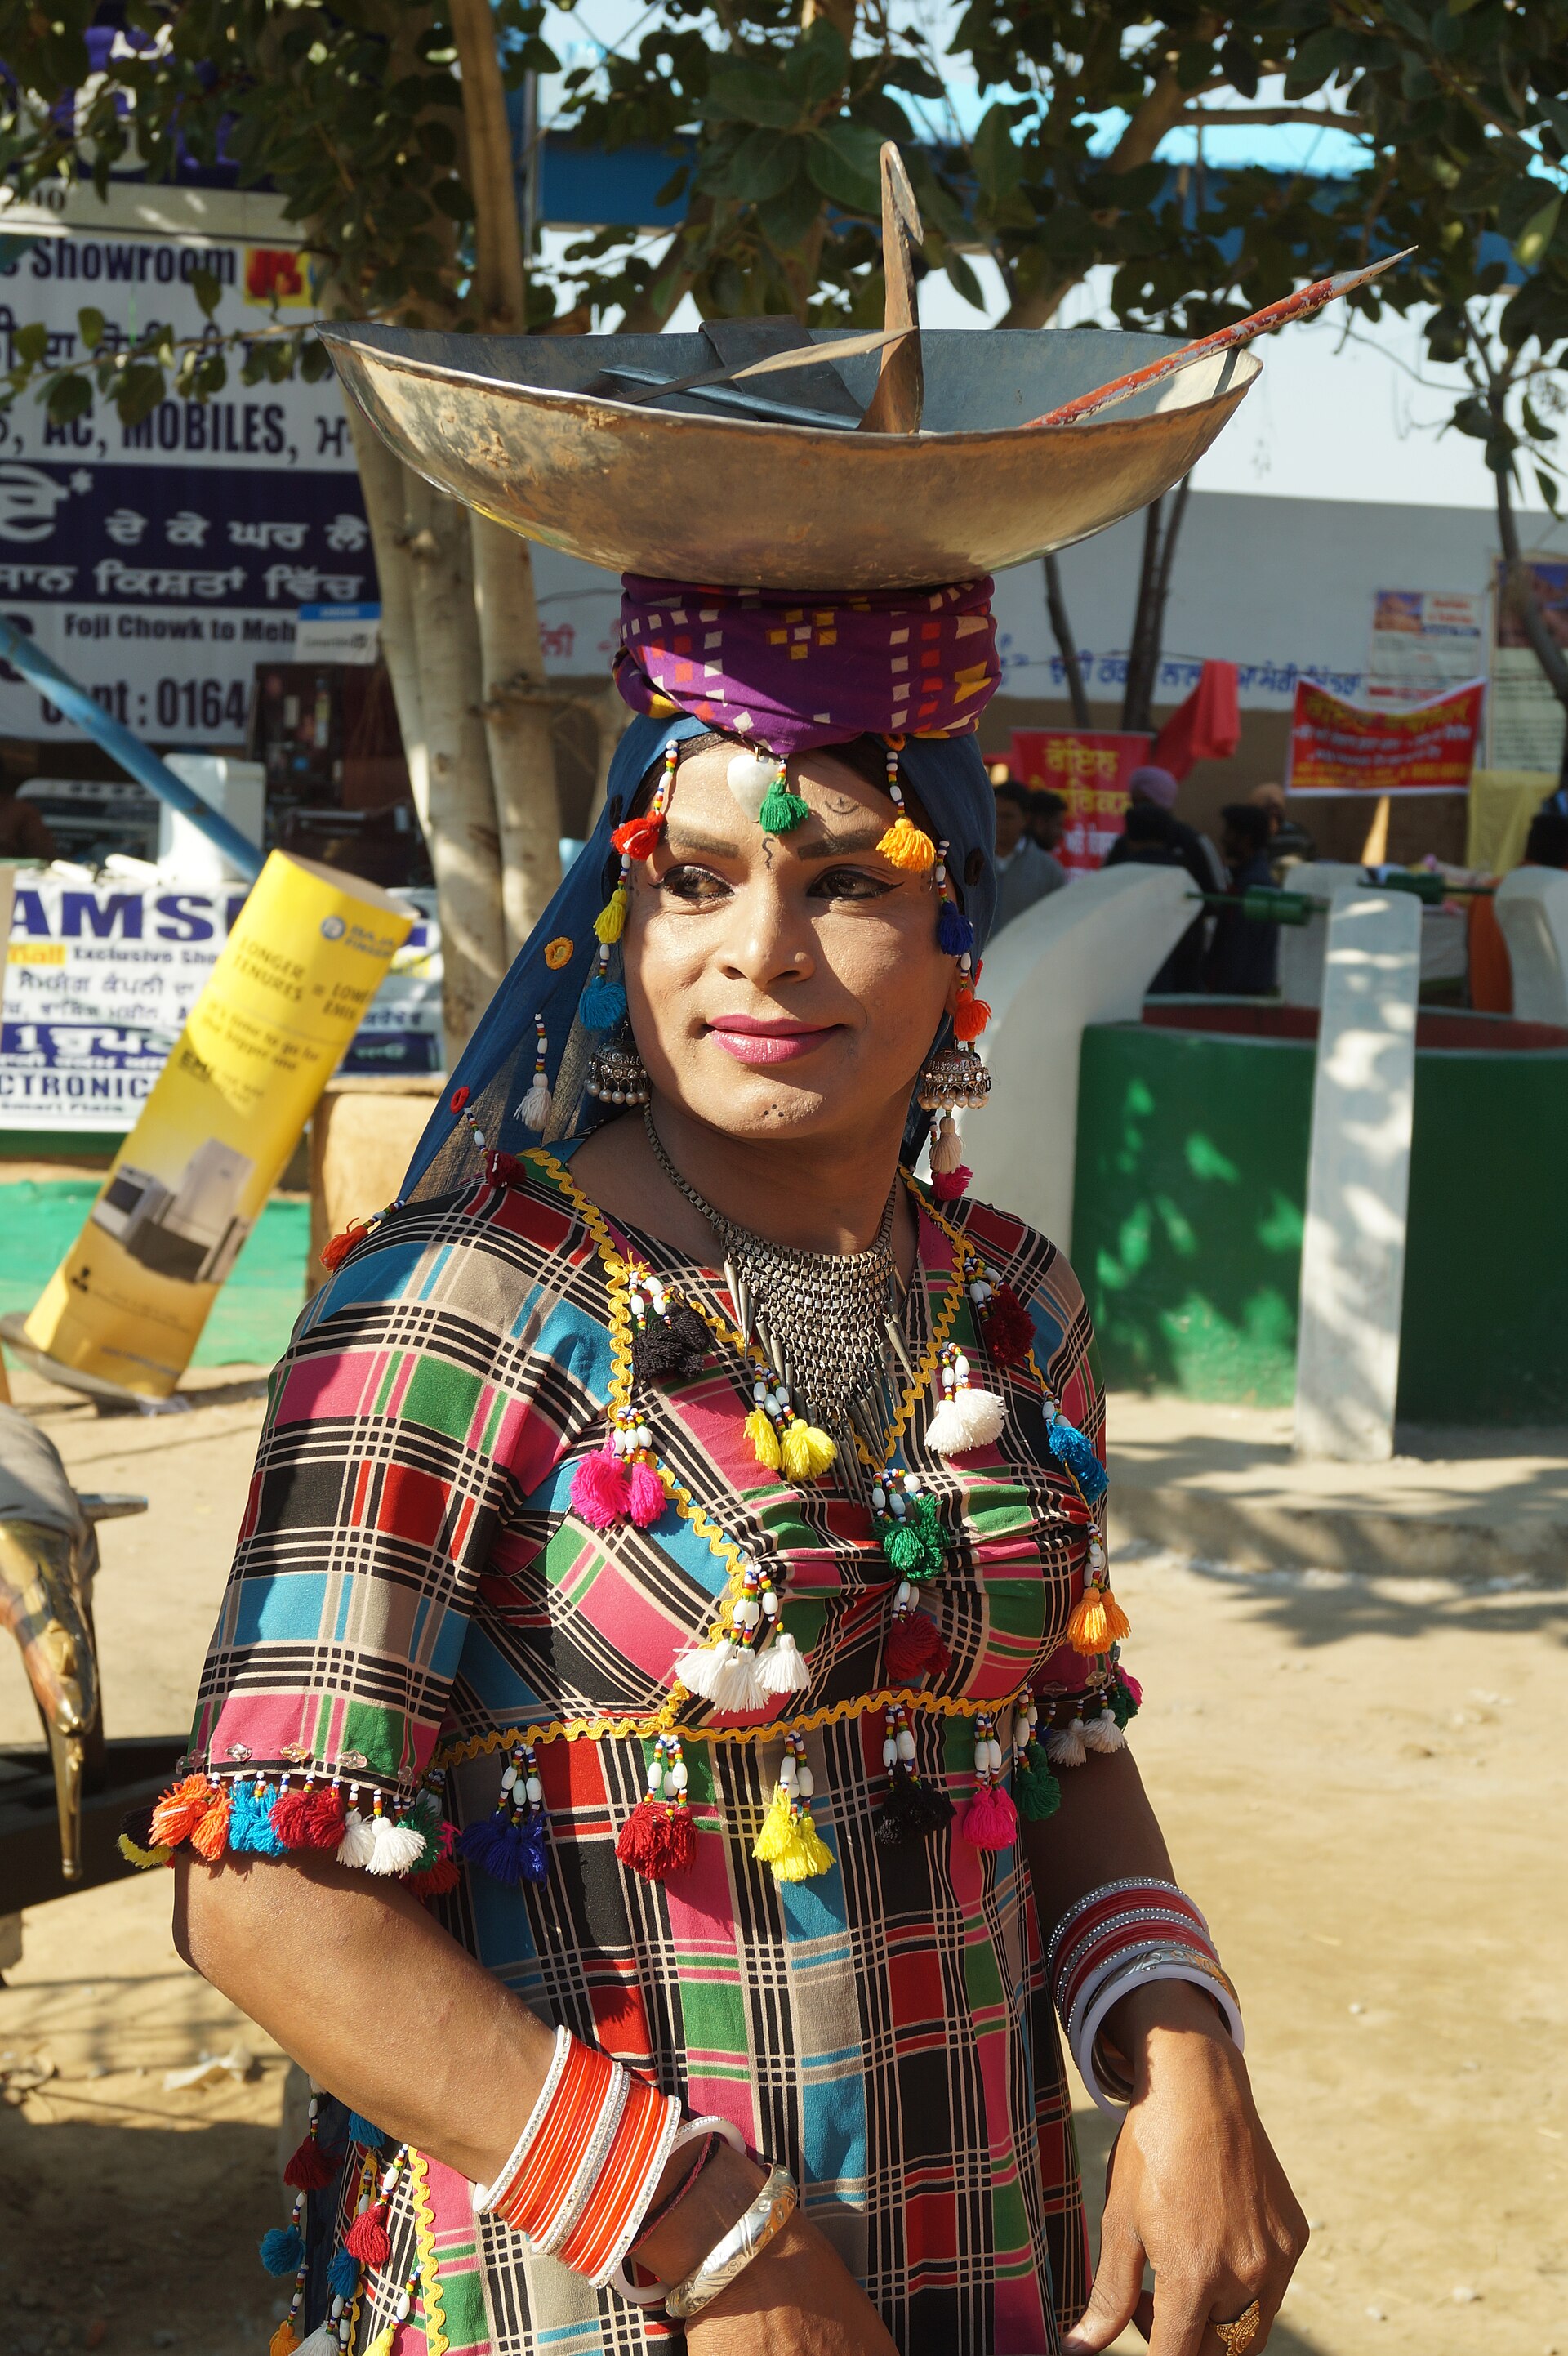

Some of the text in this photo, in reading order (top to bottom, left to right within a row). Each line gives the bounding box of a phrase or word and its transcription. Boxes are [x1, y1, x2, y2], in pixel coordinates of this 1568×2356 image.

[31, 238, 236, 285] Showroom
[65, 613, 110, 640] Foji
[117, 616, 204, 641] Chowk
[211, 620, 236, 641] to
[74, 945, 173, 965] Exclusive
